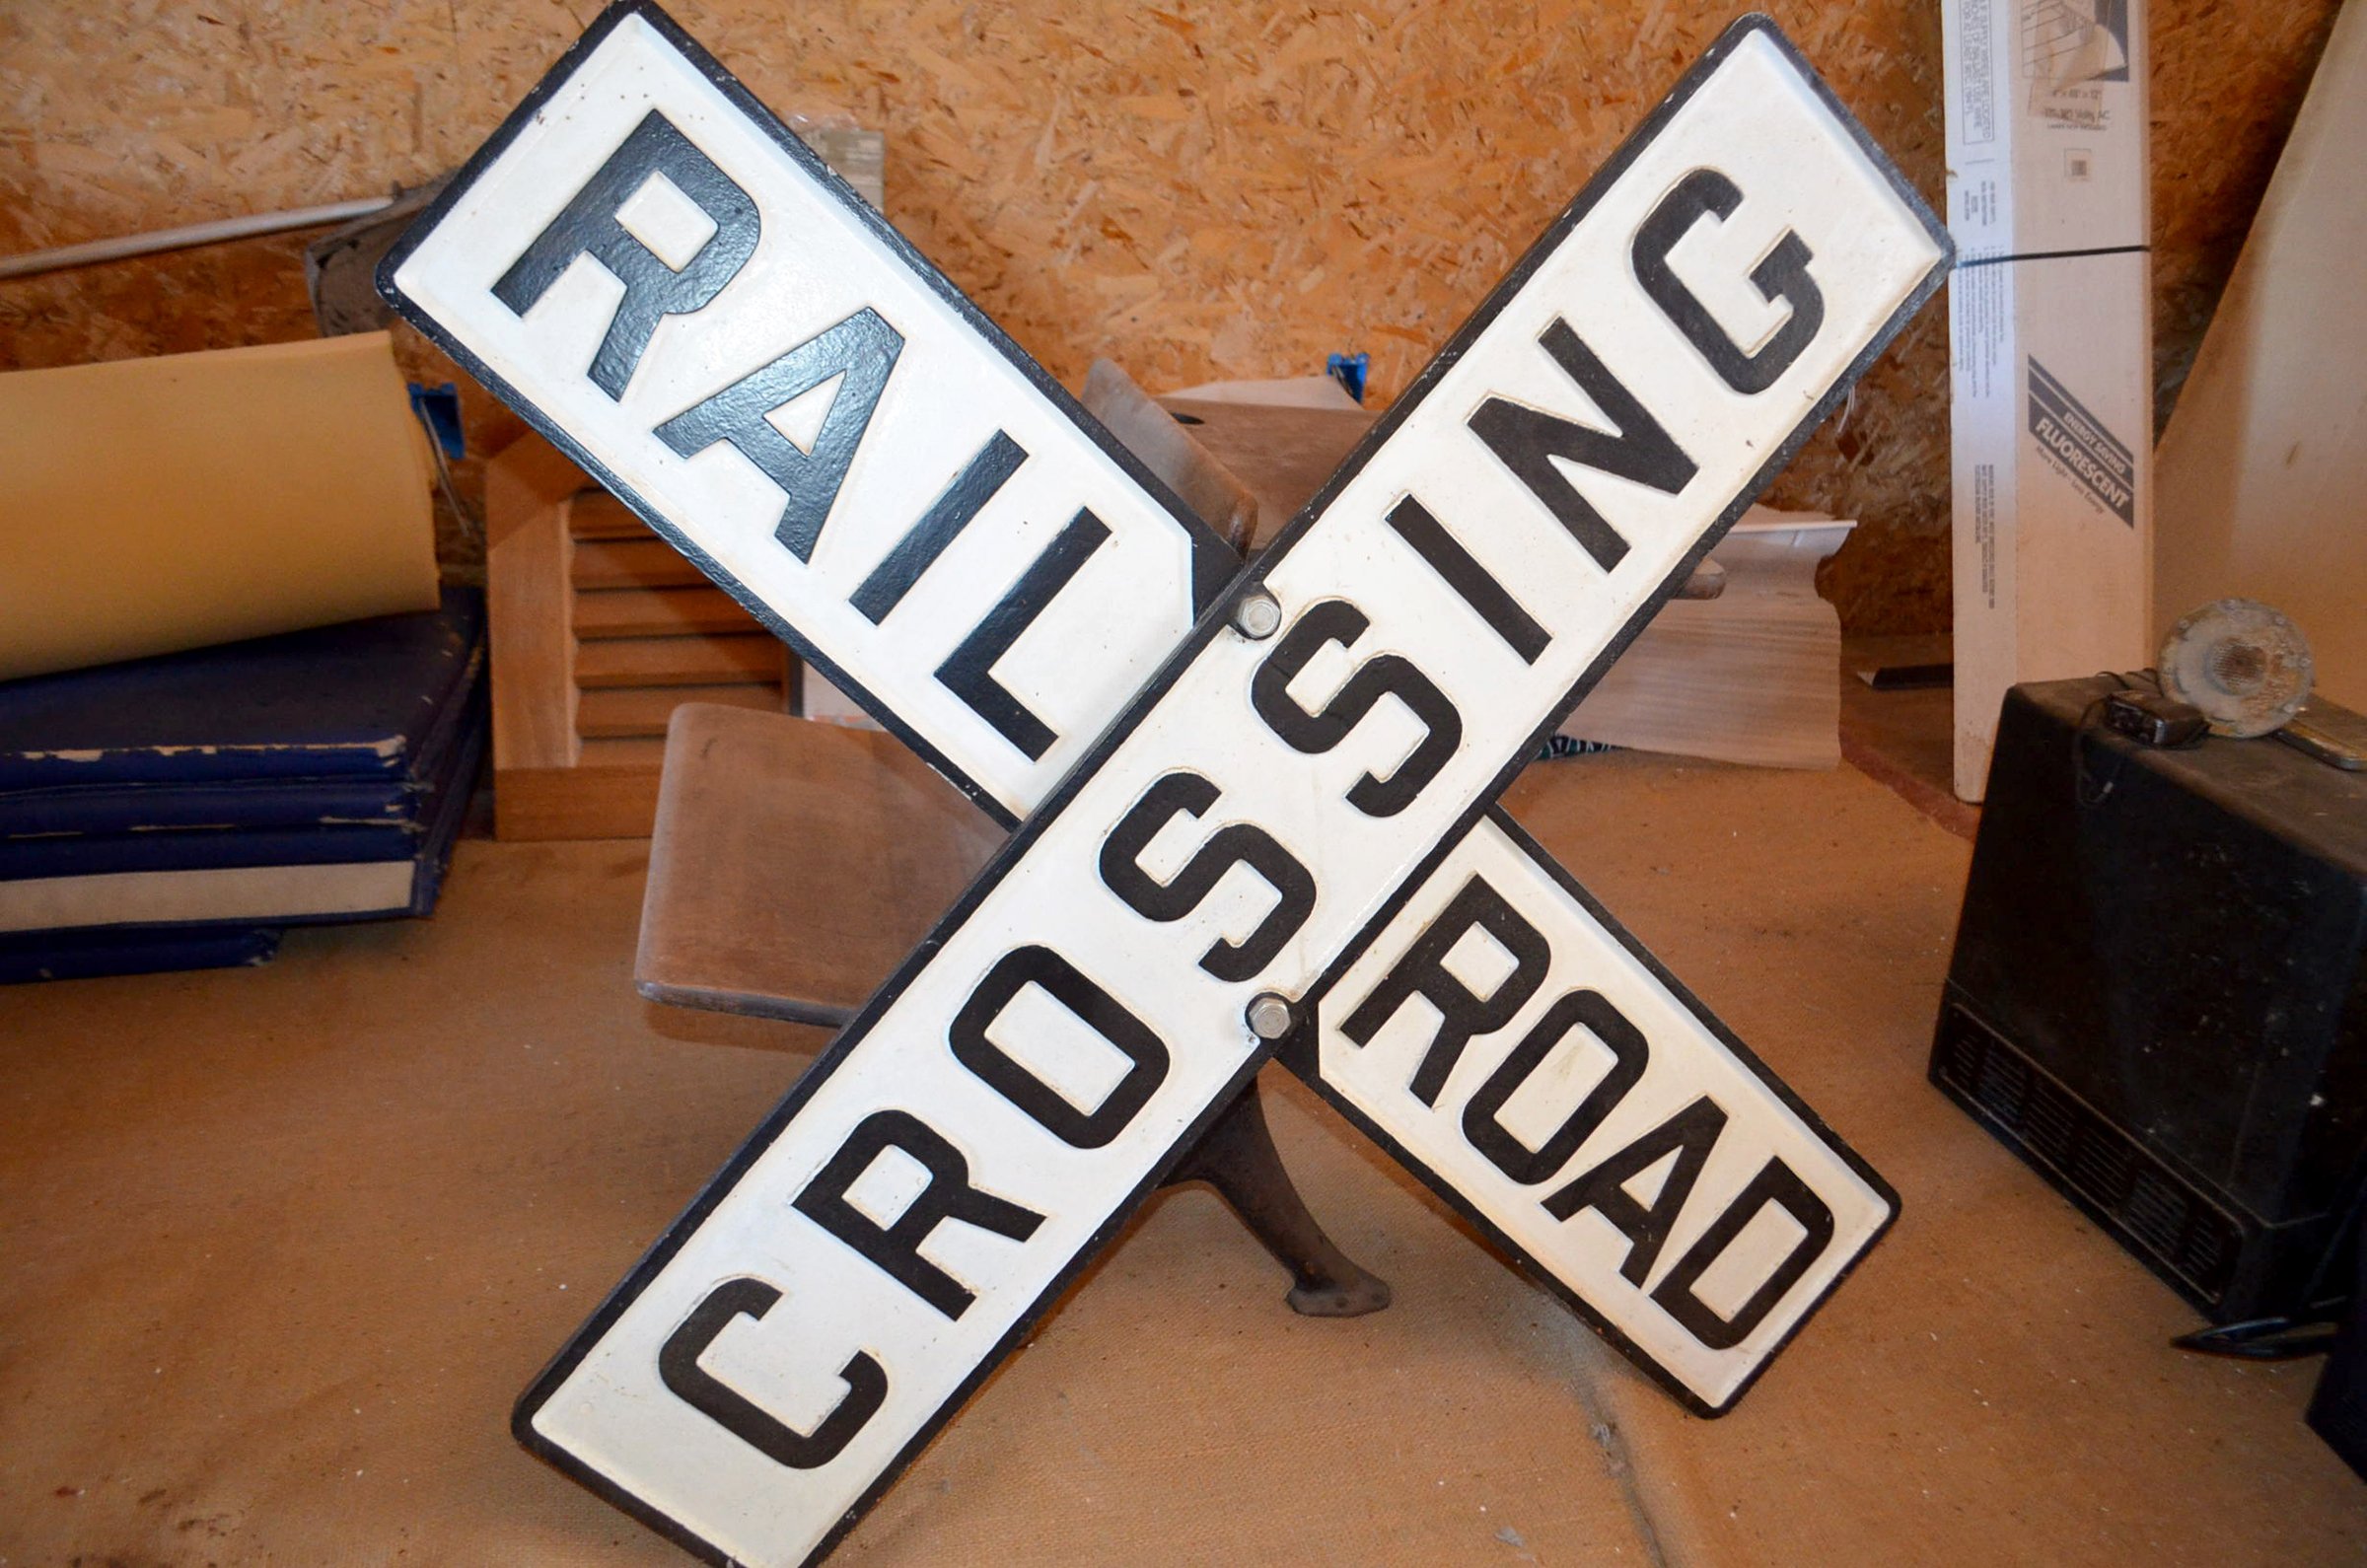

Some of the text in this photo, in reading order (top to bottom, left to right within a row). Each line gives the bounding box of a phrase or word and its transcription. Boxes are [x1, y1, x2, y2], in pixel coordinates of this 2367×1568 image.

[494, 109, 1111, 760] RAIL
[2035, 417, 2130, 508] FLUORESCENT
[2063, 412, 2126, 474] ENERGY SAVING
[660, 169, 1824, 1469] CROSSING
[1340, 874, 1834, 1350] ROAD
